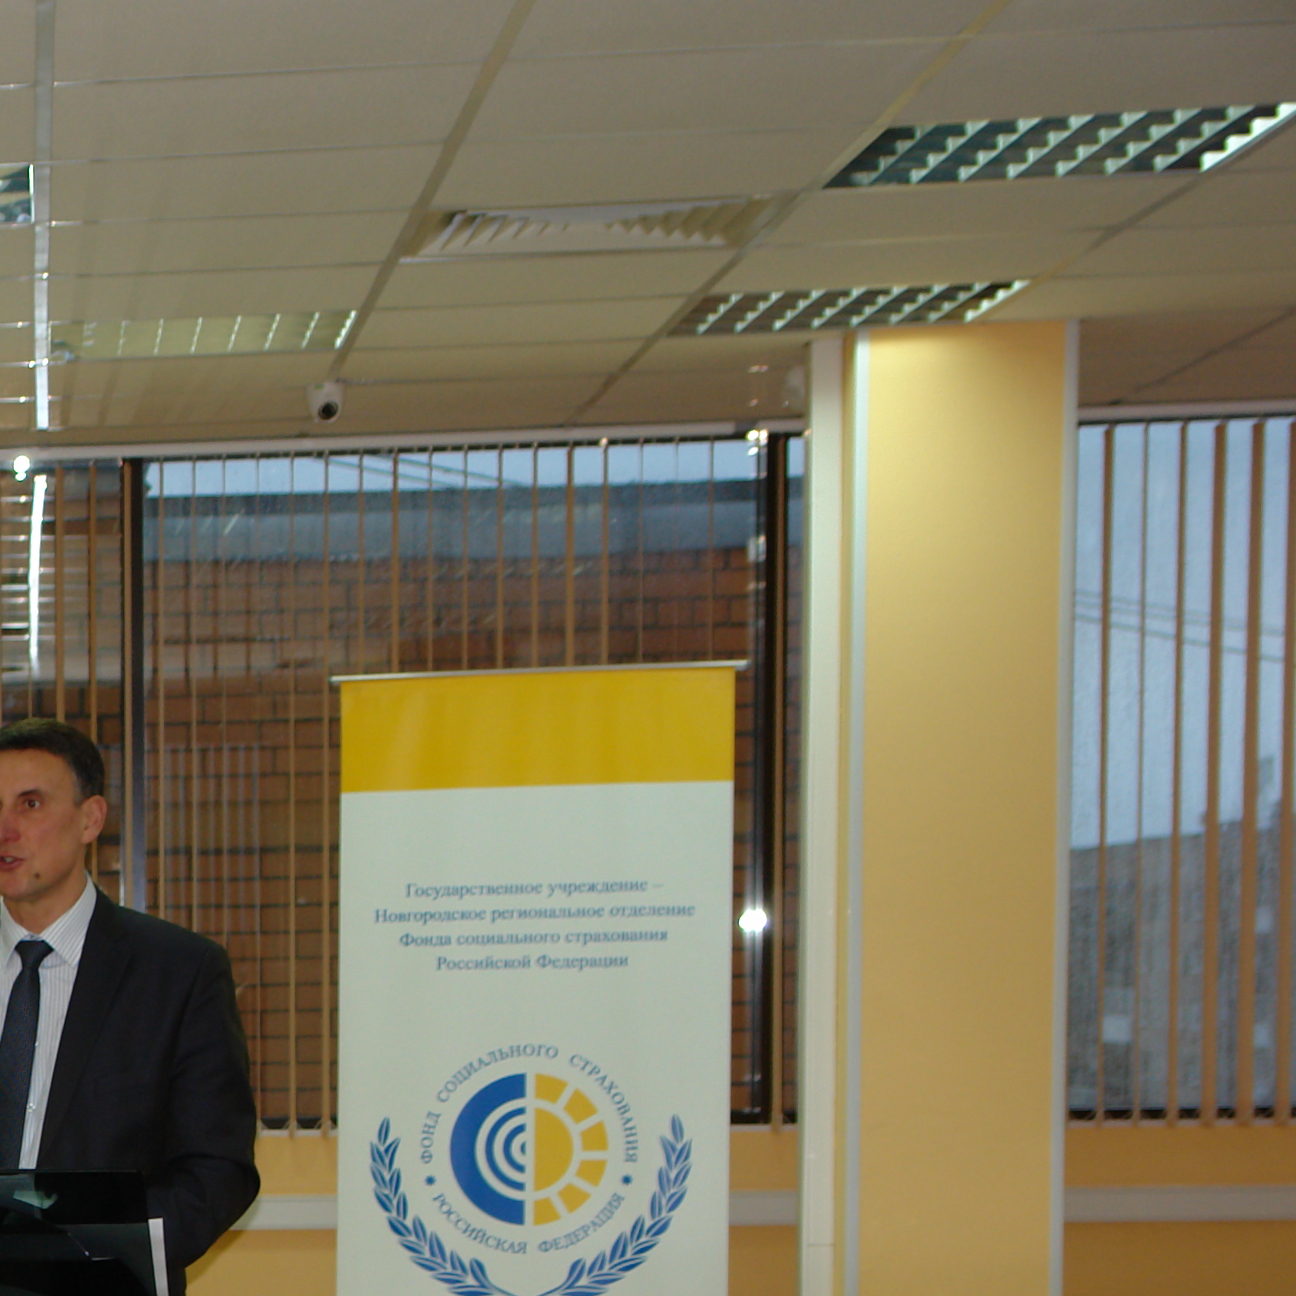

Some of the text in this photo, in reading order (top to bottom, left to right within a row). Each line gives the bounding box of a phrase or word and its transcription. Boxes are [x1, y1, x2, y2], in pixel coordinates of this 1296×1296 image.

[405, 880, 647, 900] Государственное учреждение
[374, 904, 695, 925] Новгородское региональное отделение
[399, 930, 668, 948] Фонда социального страхования
[436, 954, 628, 972] Российской Федерации
[421, 1043, 638, 1164] ФОНД СОЦИАЛЬНОГО СТРАХОВАНИЯ
[433, 1193, 626, 1254] РОССИЙСКАЯ ФЕДЕРАЦИЯ
